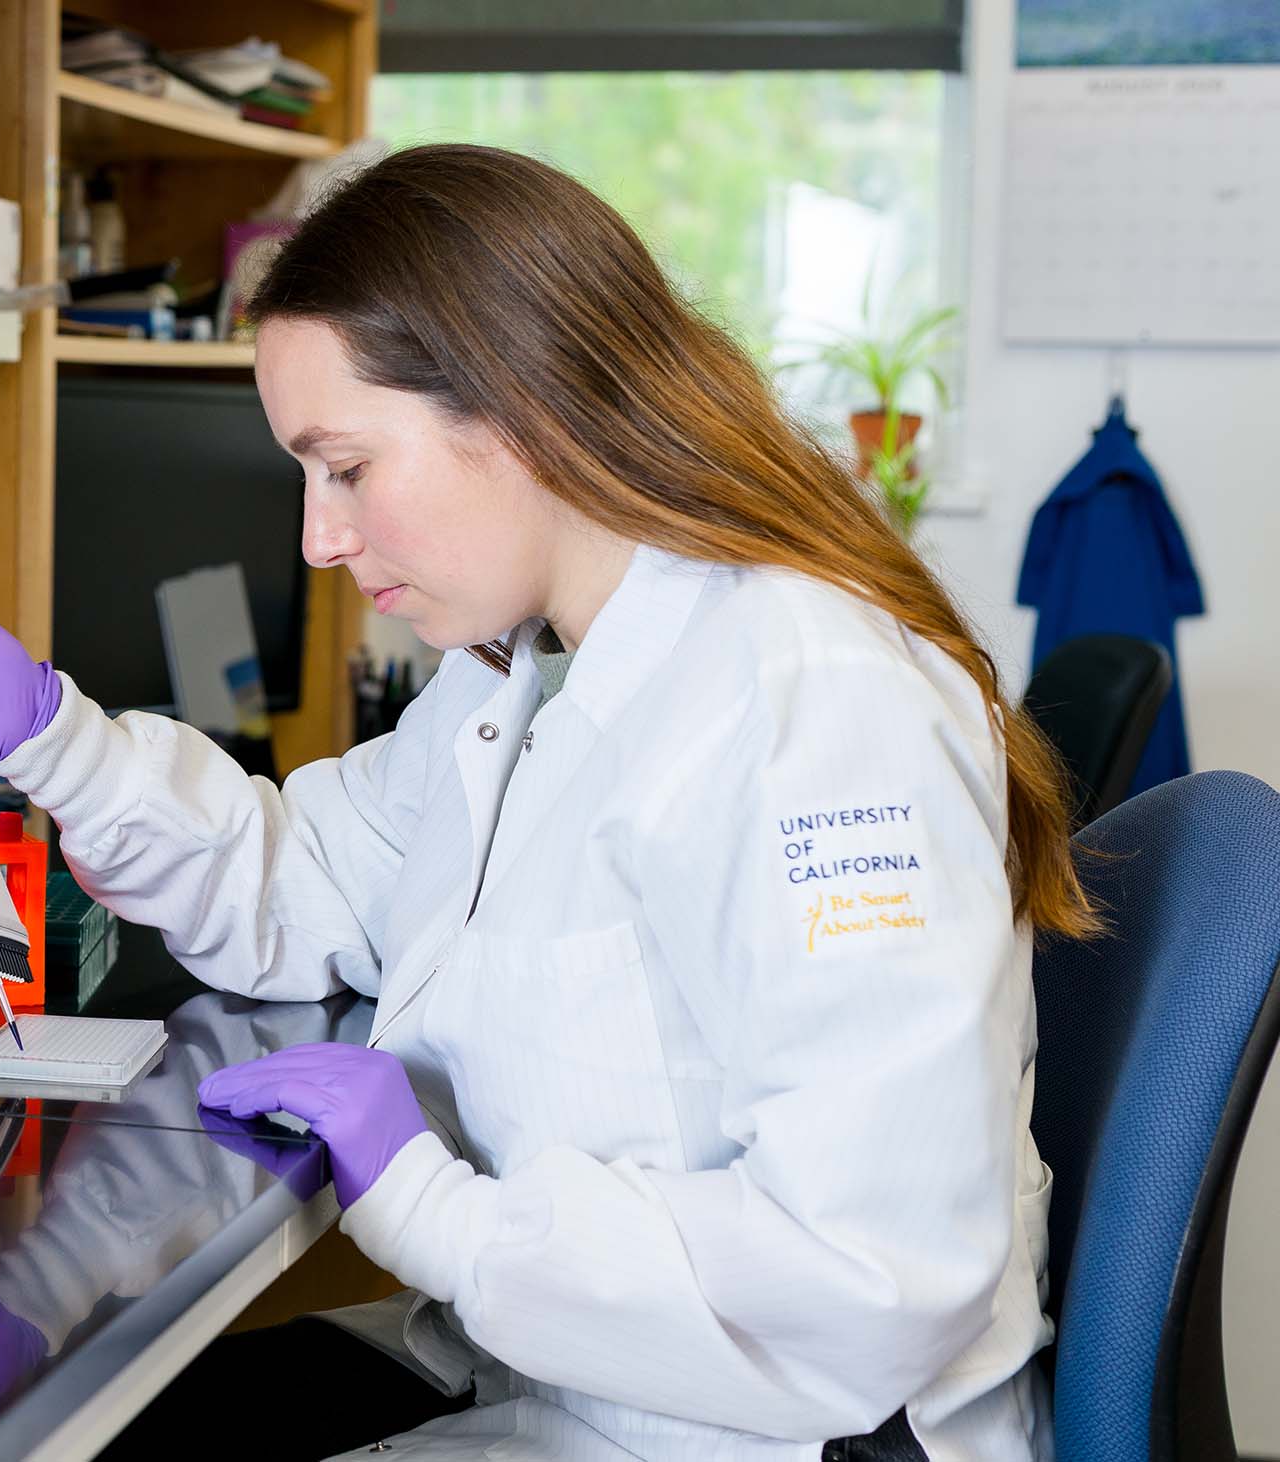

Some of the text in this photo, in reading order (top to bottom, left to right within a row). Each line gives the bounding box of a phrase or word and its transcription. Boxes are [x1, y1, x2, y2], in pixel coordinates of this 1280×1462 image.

[780, 805, 912, 835] UNIVERSITY
[785, 839, 814, 860] OF
[789, 853, 921, 884] CALIFORNIA
[830, 890, 912, 912] Be Smart
[821, 911, 926, 937] About Safety
